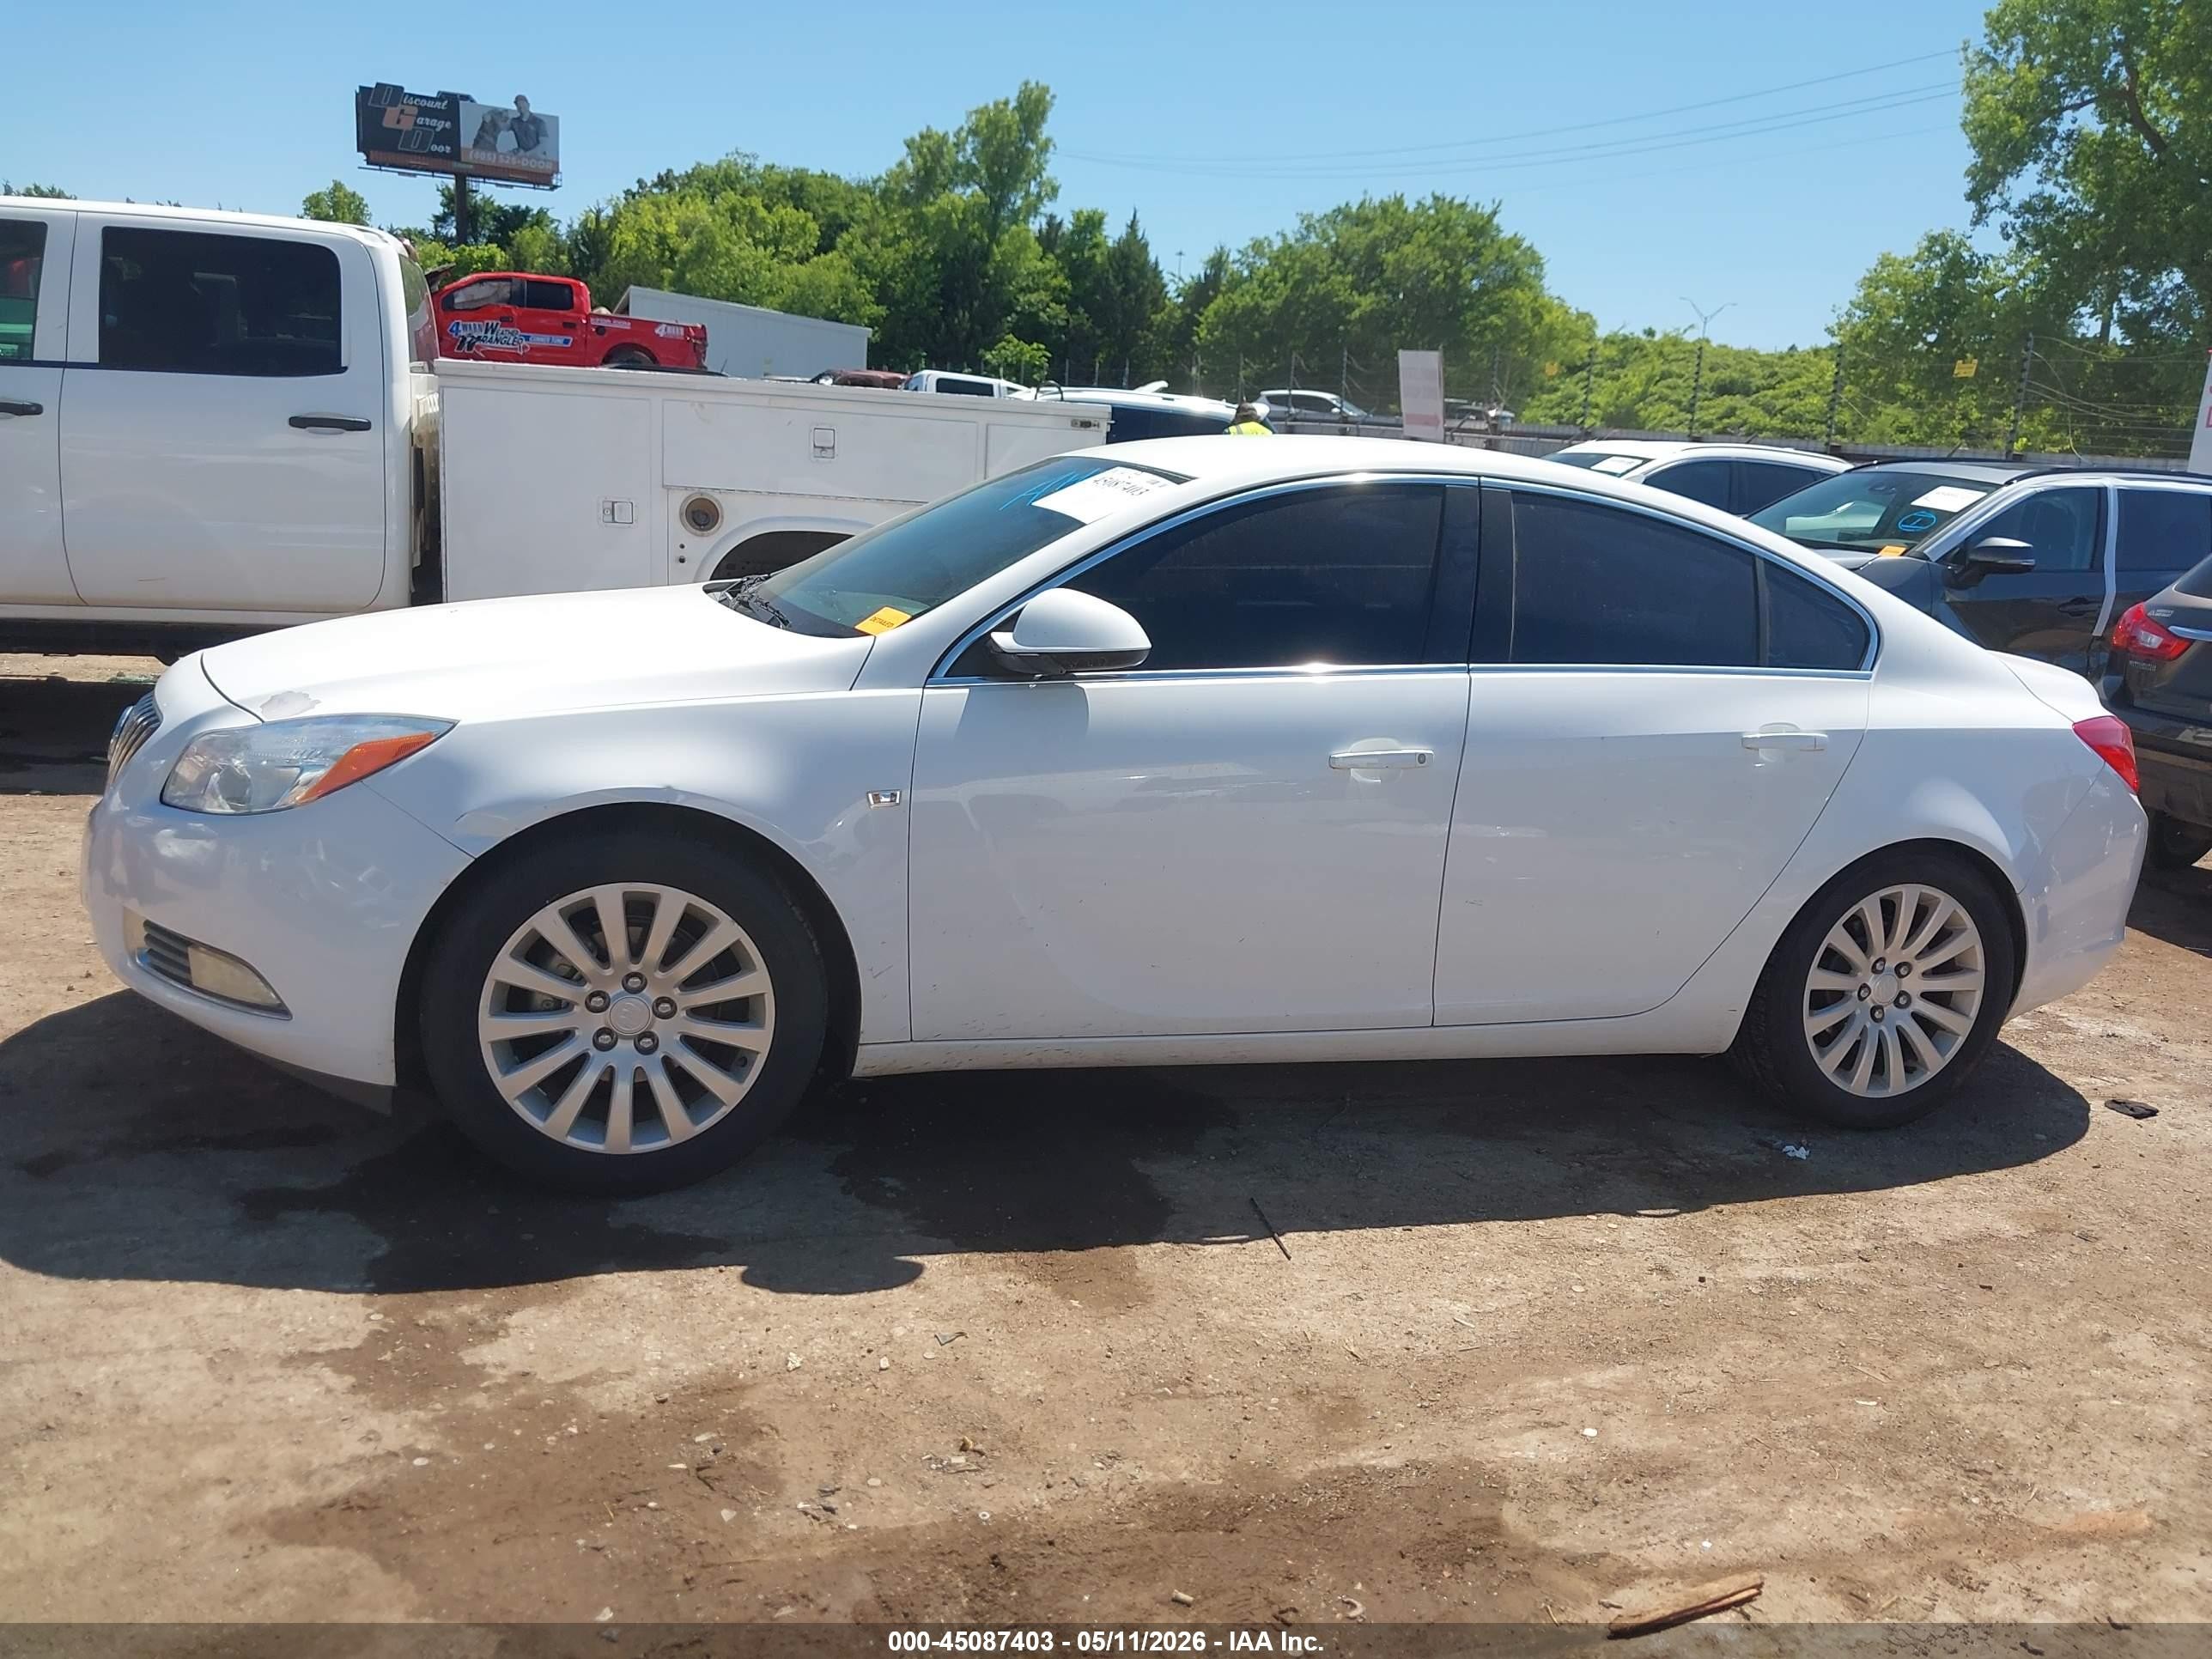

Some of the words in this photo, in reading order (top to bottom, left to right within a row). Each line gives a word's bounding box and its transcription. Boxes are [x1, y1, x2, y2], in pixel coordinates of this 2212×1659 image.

[368, 82, 449, 110] Discount
[382, 105, 453, 131] Garage
[398, 129, 453, 154] Door
[868, 615, 895, 629] DETAILED
